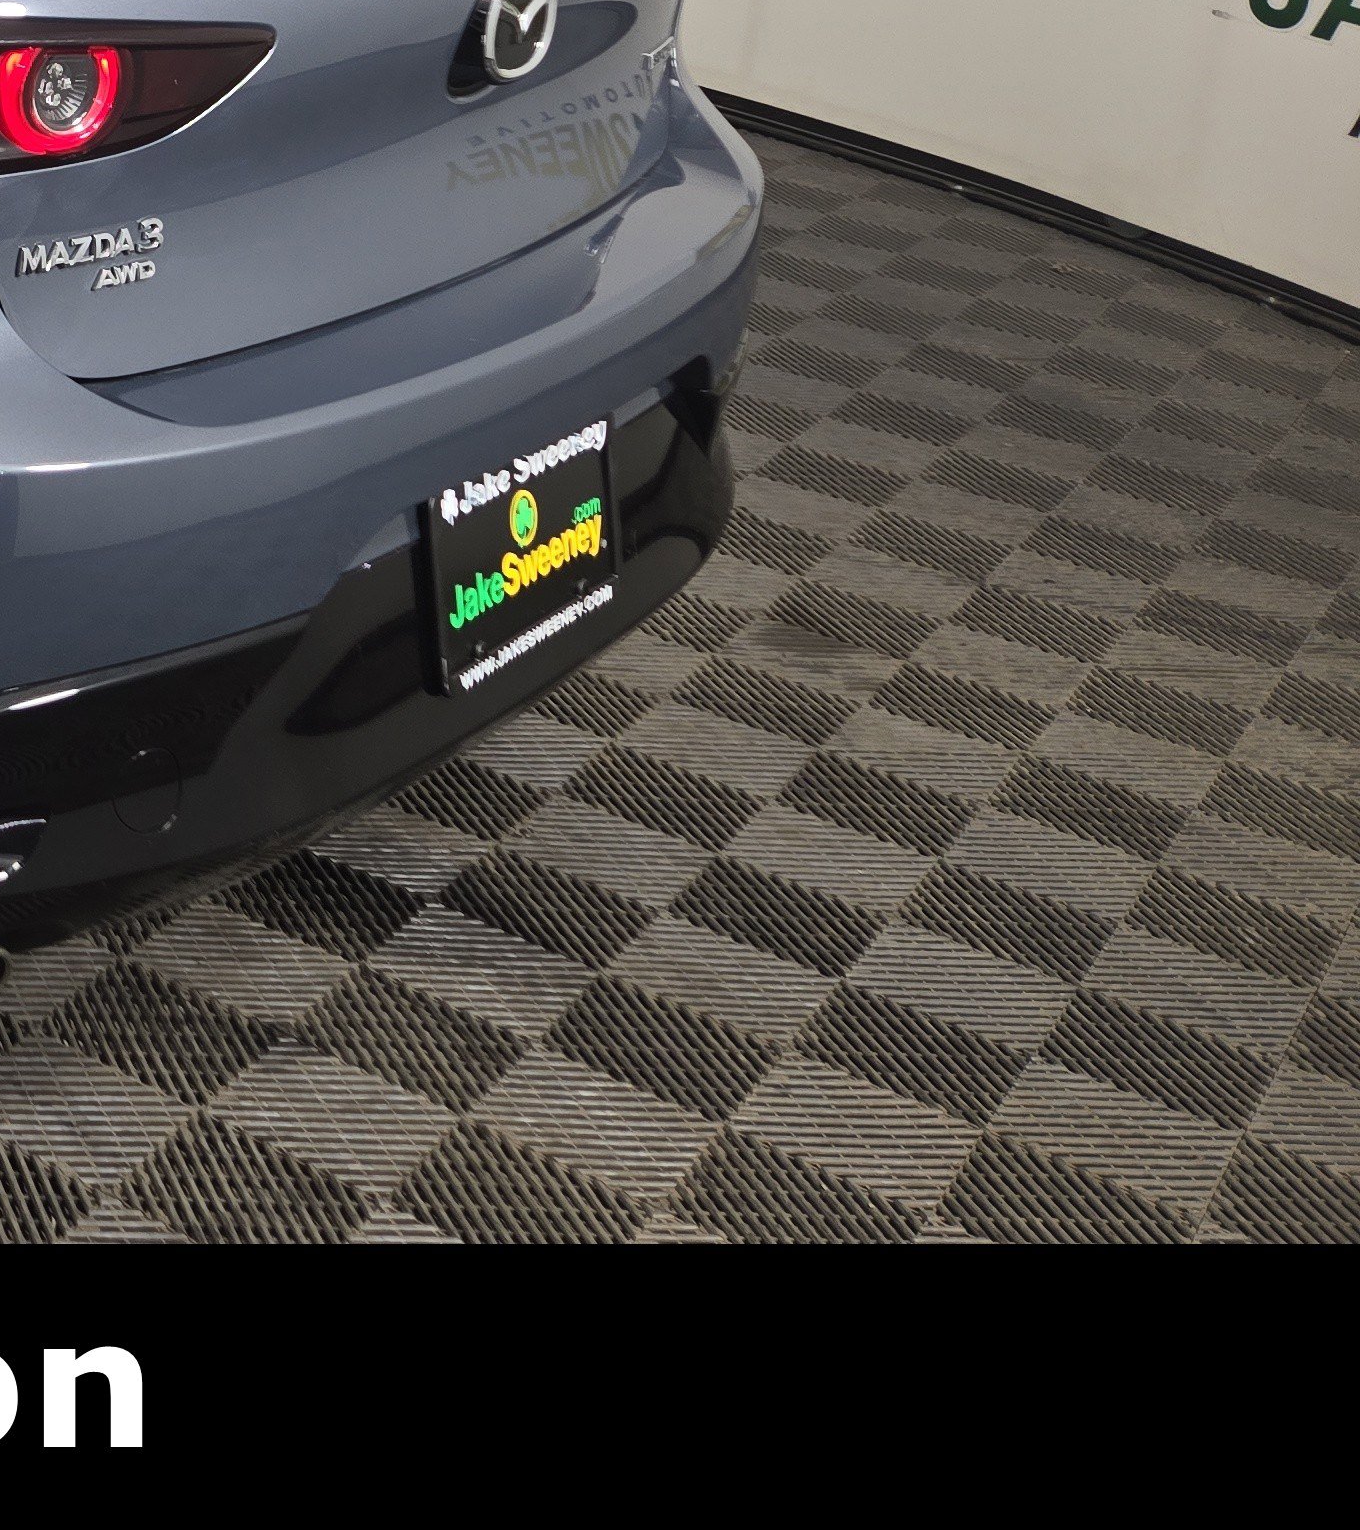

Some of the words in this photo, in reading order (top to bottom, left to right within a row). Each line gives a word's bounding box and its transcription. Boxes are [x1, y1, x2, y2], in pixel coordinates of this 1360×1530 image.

[91, 260, 156, 291] AWD
[459, 469, 511, 514] Jake
[513, 420, 607, 483] Sweeney
[449, 514, 603, 629] JakeSweeney
